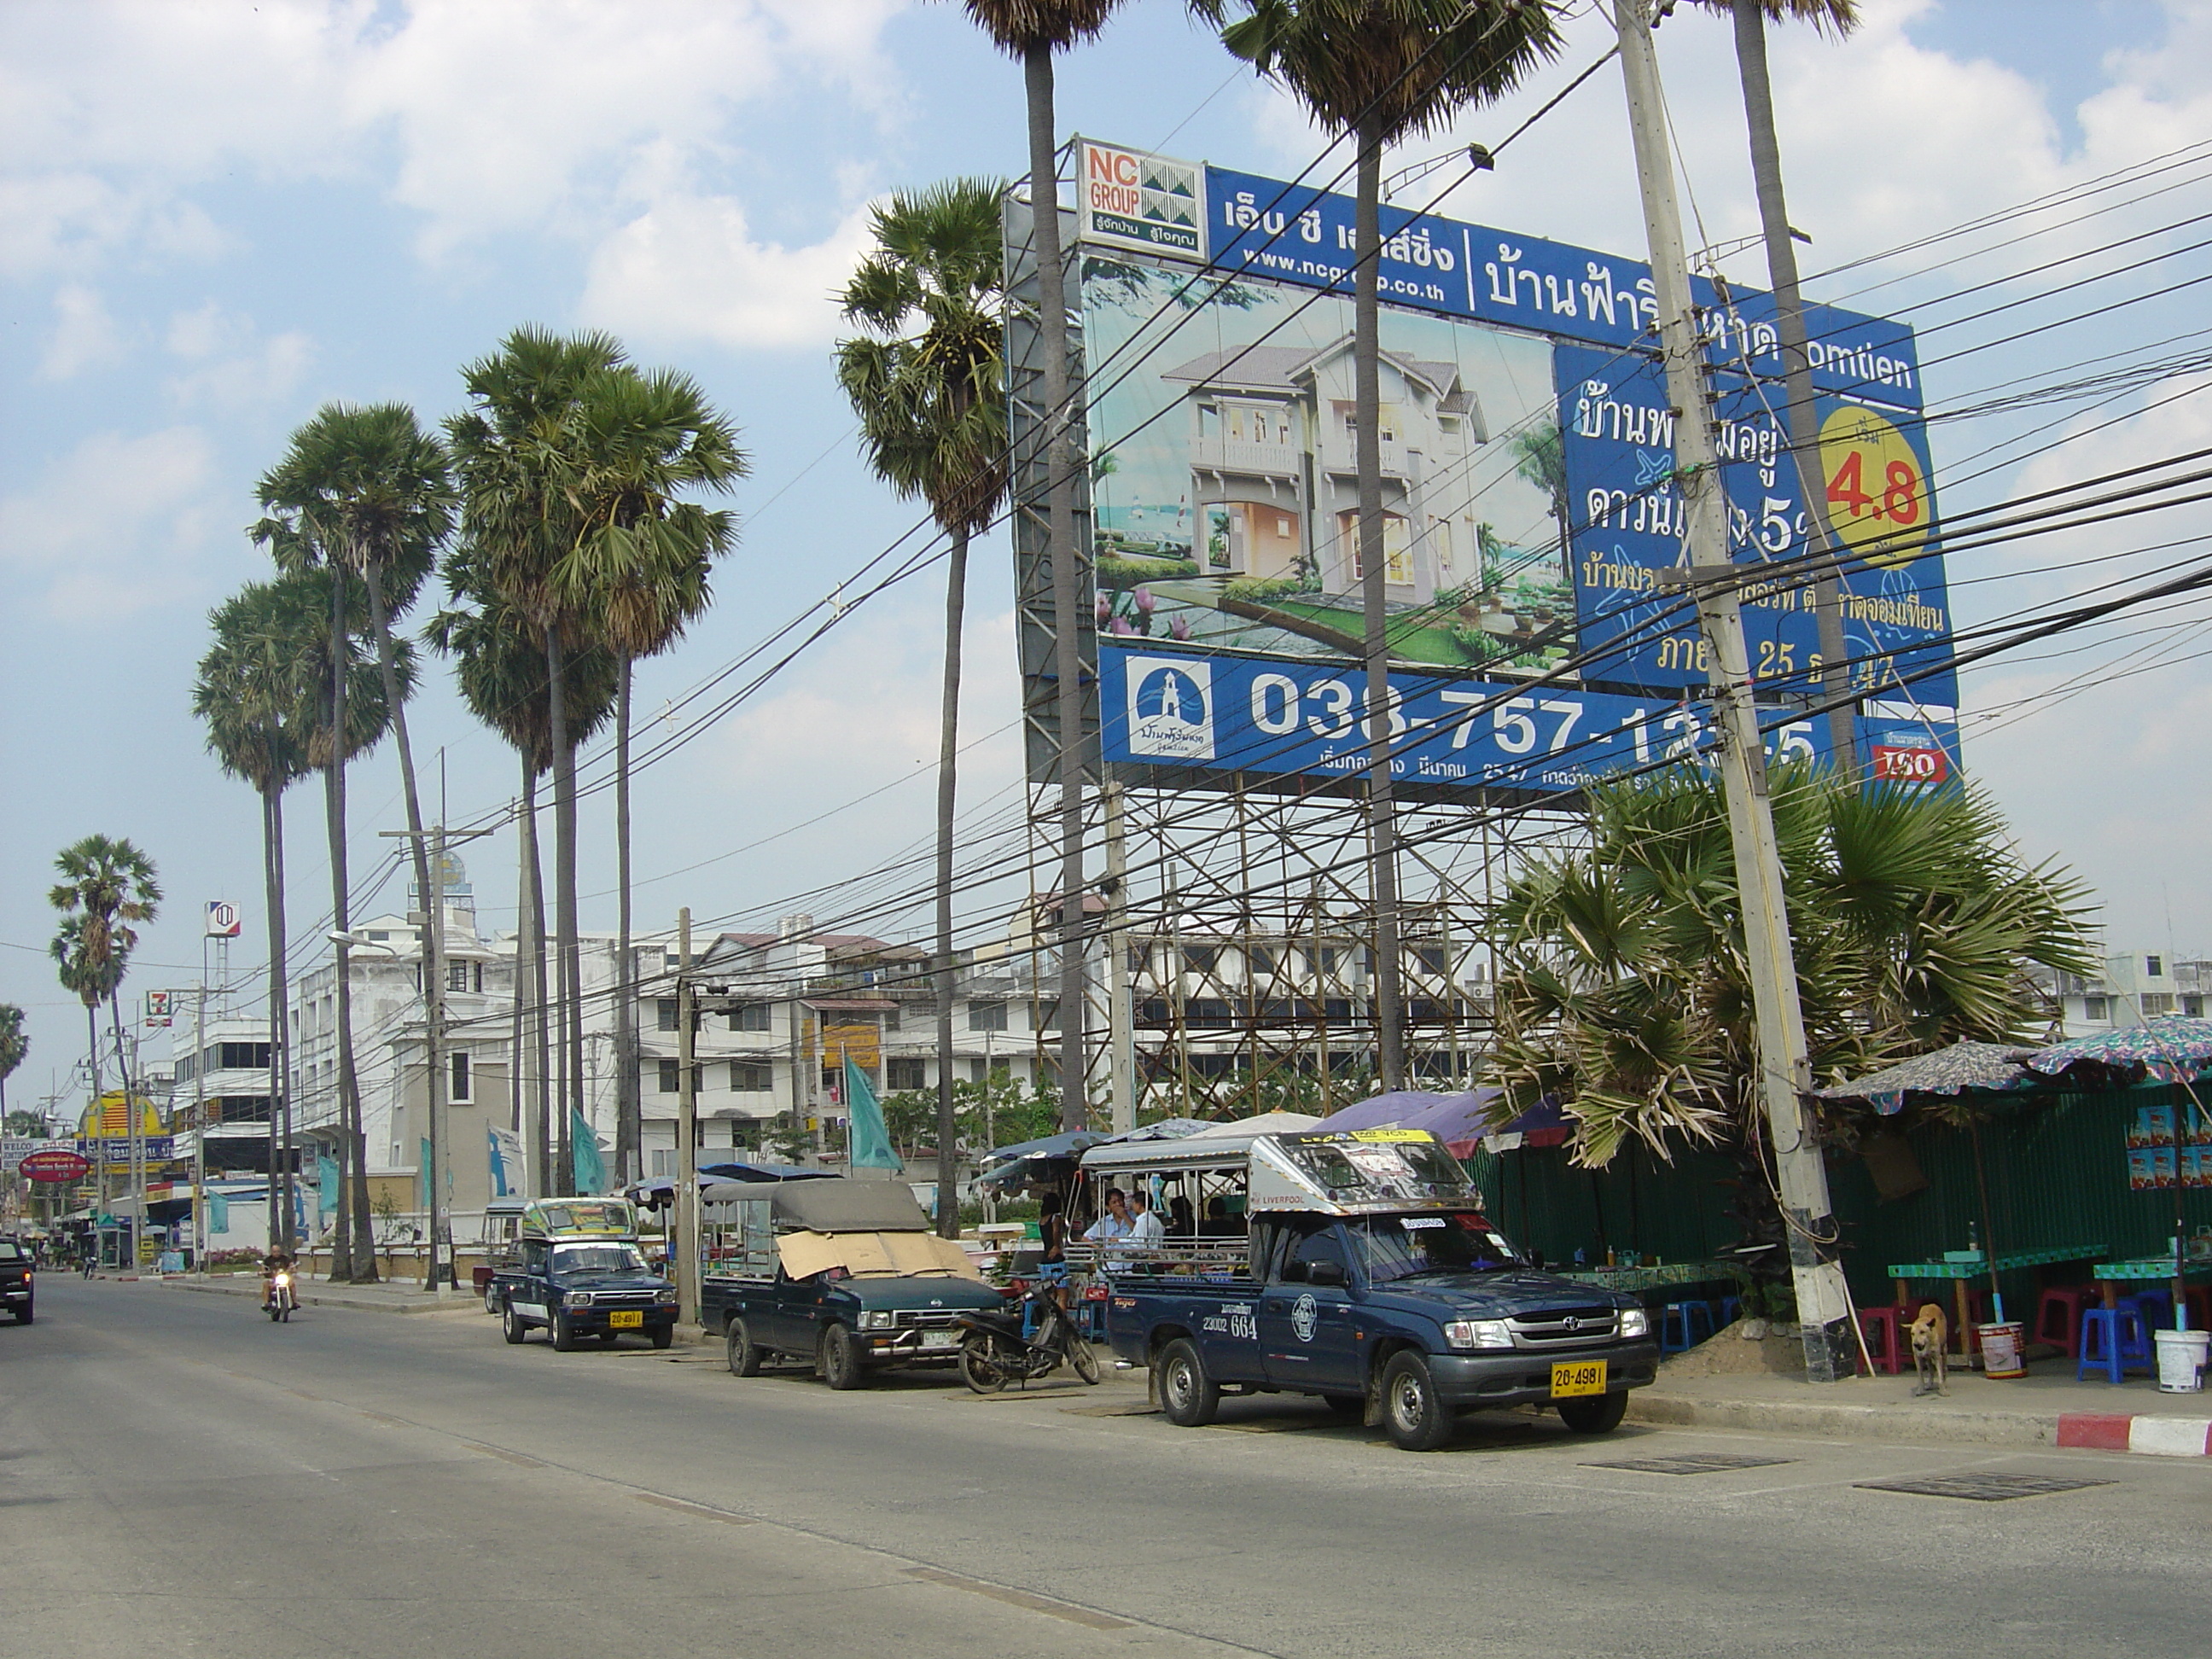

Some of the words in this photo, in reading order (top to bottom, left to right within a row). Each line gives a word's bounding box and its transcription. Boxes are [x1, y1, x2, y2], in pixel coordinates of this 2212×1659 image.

[1090, 148, 1138, 186] NC
[1091, 182, 1139, 216] GROUP
[1225, 191, 1285, 237] เอ็น
[1298, 209, 1322, 243] ซี
[1243, 248, 1445, 302] www.ncgrp.co.th
[1807, 341, 1912, 389] omtien
[1826, 451, 1918, 525] 4.8
[1758, 641, 1796, 680] 25
[1883, 751, 1936, 777] ISO
[1263, 1196, 1305, 1205] LIVERPOOL
[1231, 1314, 1258, 1340] 664
[1555, 1367, 1602, 1387] 20-4981
